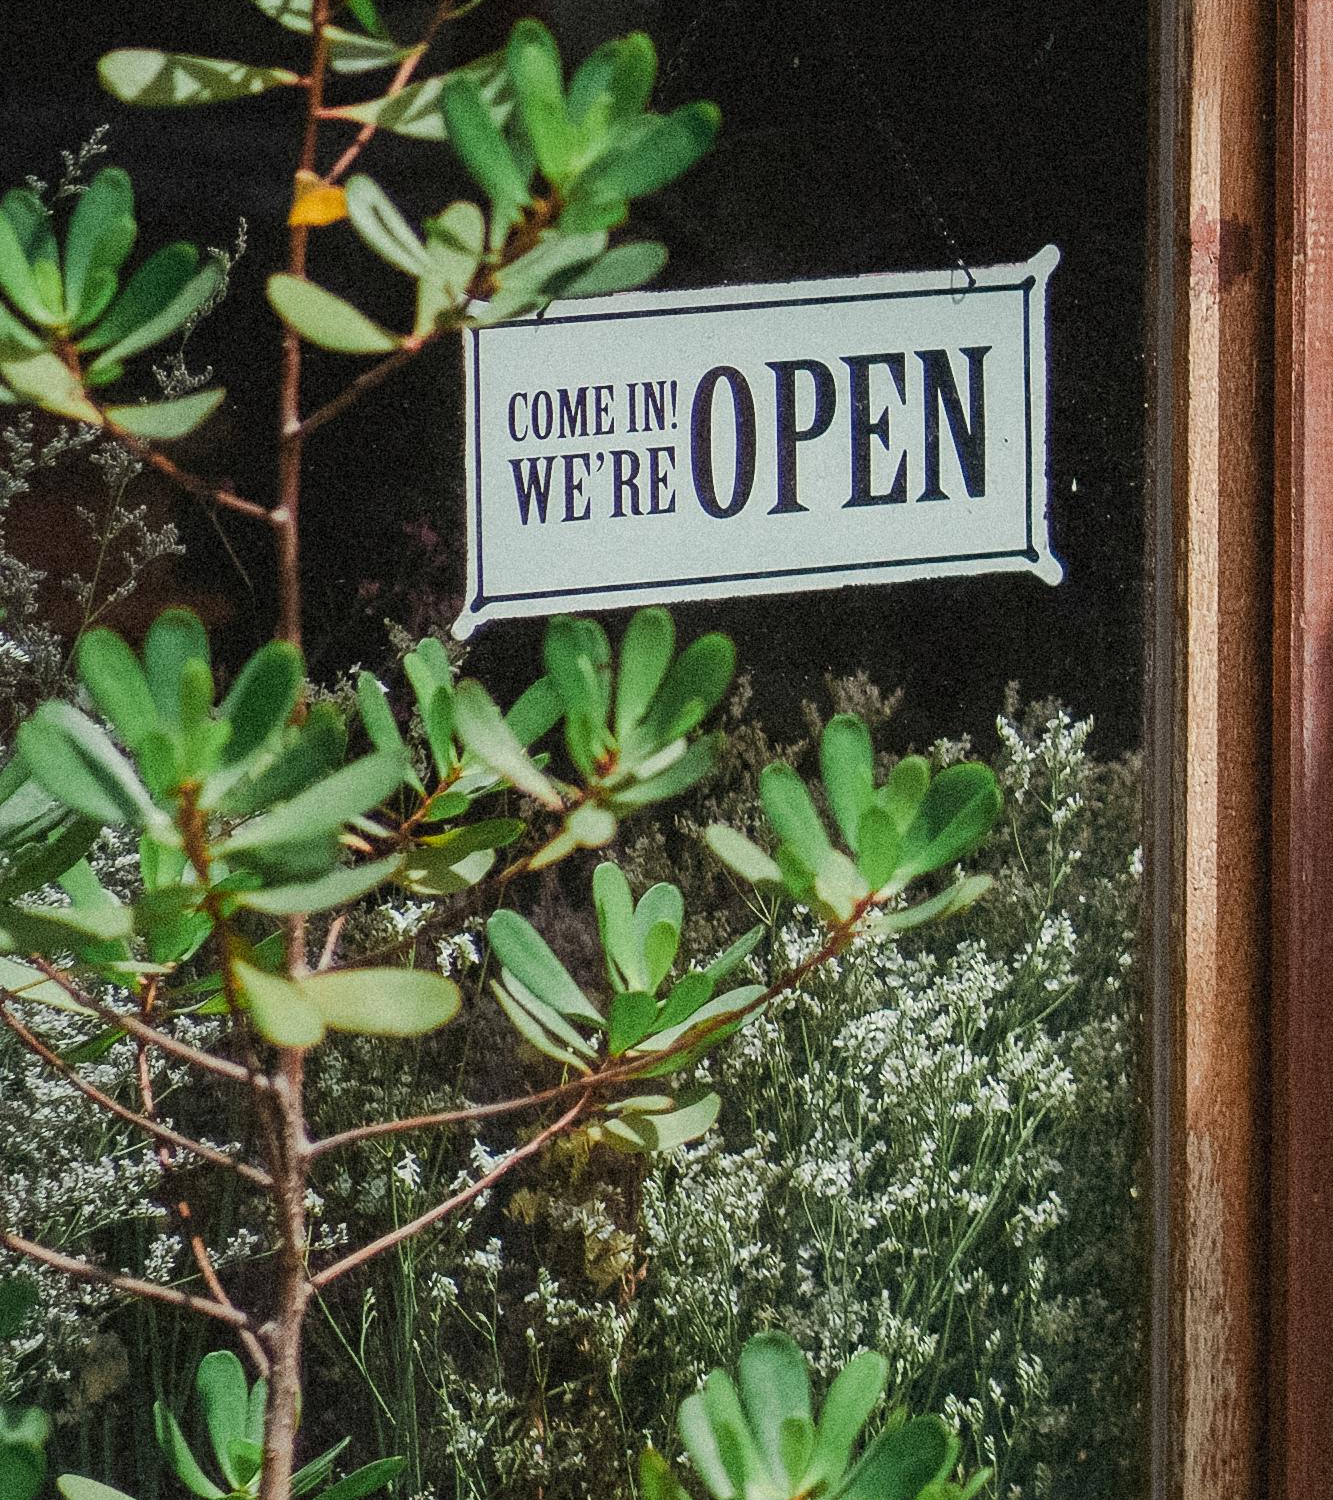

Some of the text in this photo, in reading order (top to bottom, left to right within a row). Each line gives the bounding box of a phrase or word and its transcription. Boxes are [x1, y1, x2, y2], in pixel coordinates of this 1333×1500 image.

[508, 380, 679, 443] COME IN!
[690, 345, 993, 520] OPEN
[508, 446, 677, 526] WE'RE
